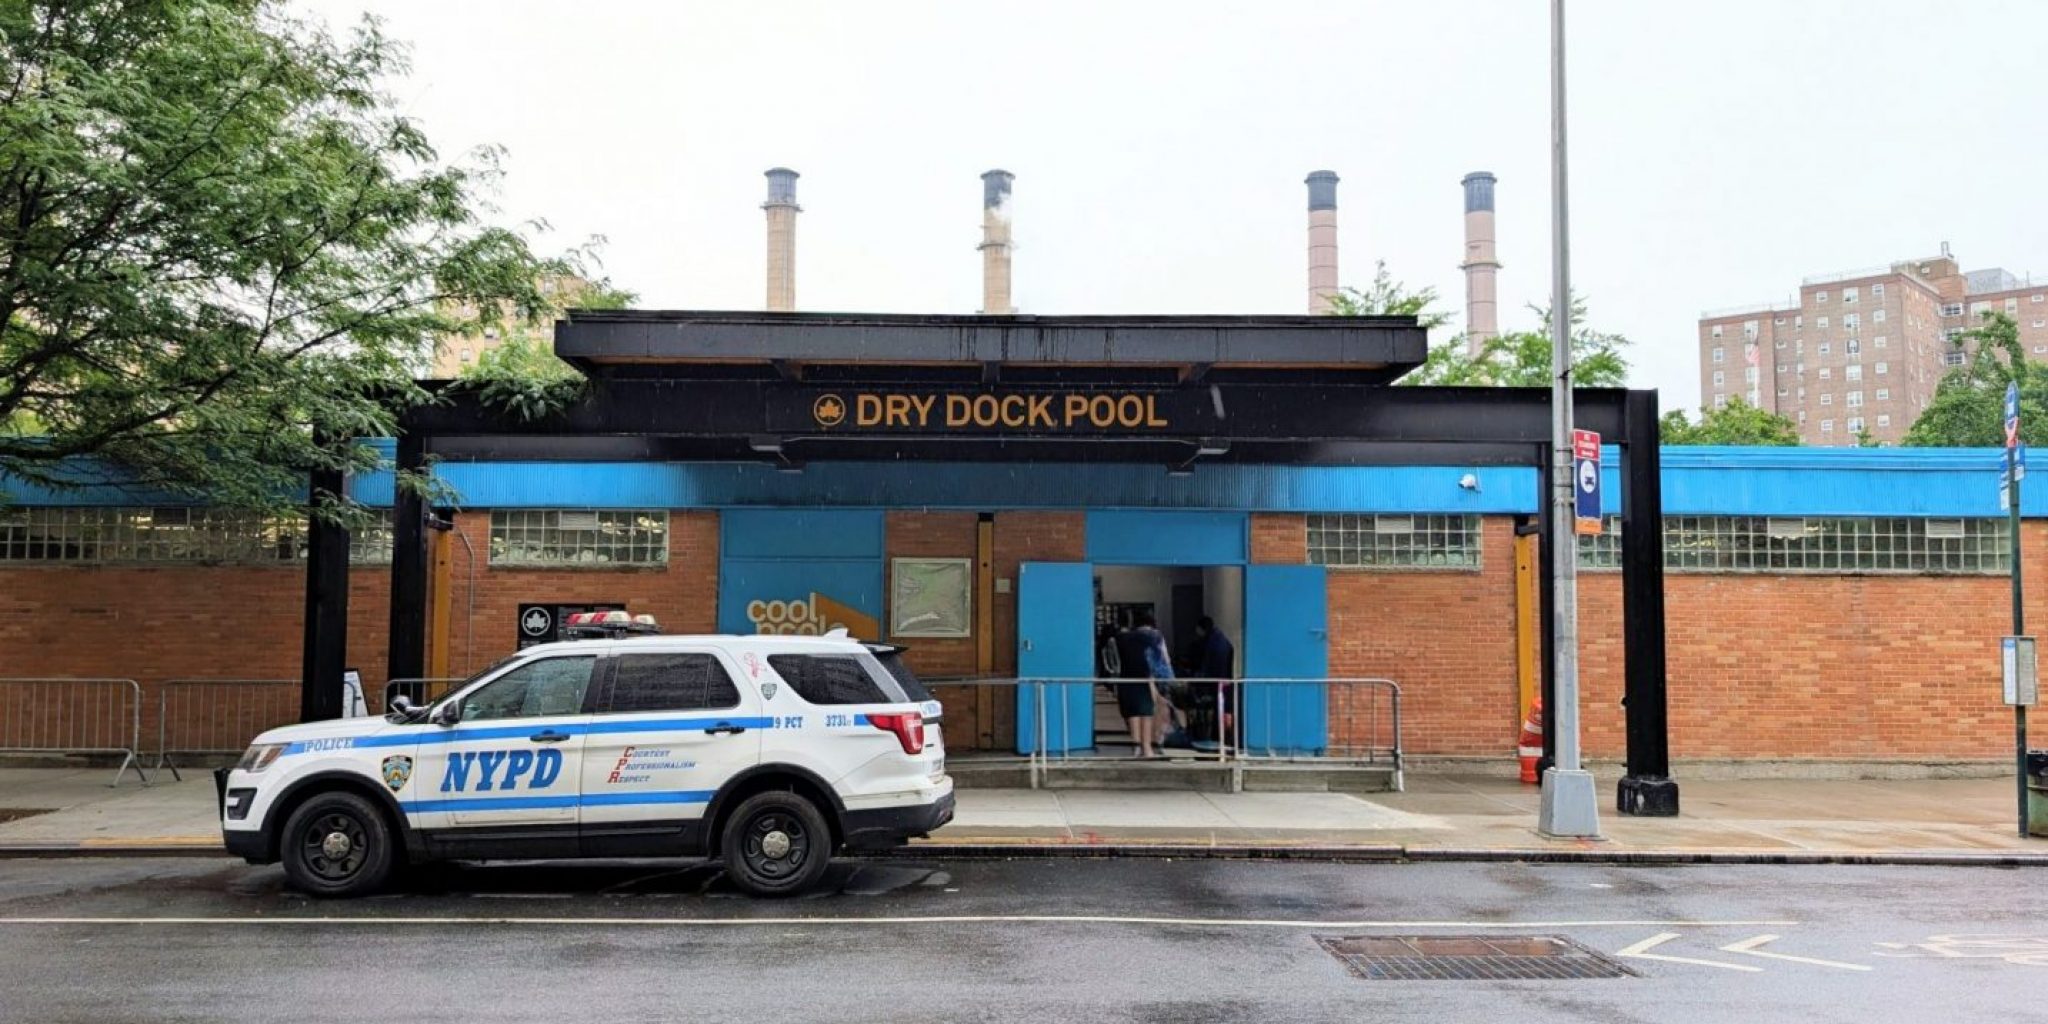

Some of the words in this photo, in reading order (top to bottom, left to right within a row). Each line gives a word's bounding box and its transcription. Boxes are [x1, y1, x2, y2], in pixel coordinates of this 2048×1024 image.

[857, 394, 936, 426] DRY
[946, 394, 1053, 427] DOCK
[1065, 394, 1168, 427] POOL
[746, 592, 818, 622] cool
[775, 717, 780, 728] 9
[785, 716, 803, 728] PCT
[305, 737, 352, 751] POLICE
[440, 748, 562, 791] NYPD
